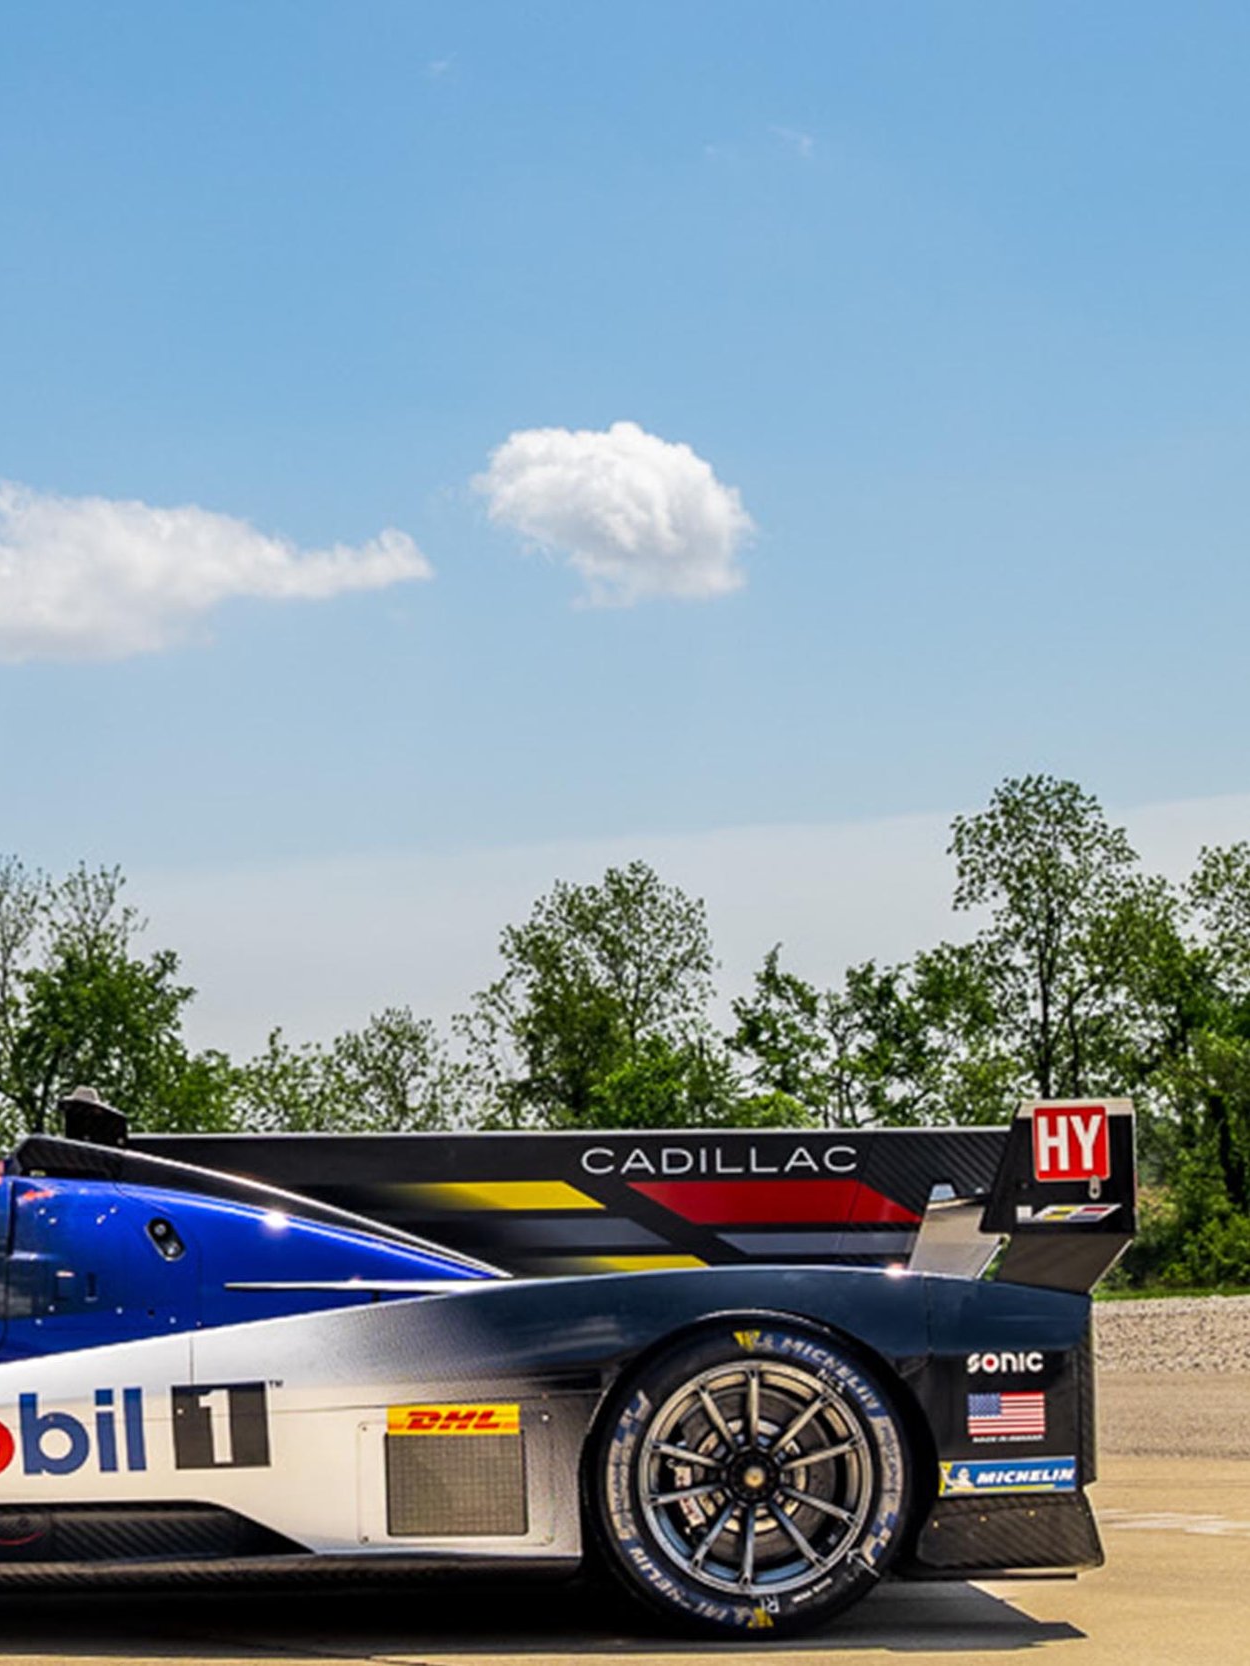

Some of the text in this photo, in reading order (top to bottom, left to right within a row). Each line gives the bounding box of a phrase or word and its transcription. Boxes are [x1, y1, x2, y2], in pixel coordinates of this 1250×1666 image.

[581, 1146, 857, 1174] CADILLAC
[1037, 1115, 1103, 1171] HY
[781, 1338, 880, 1409] MICHELIN
[198, 1389, 234, 1464] 1
[407, 1411, 501, 1430] DHL
[976, 1468, 1075, 1484] MICHELIN
